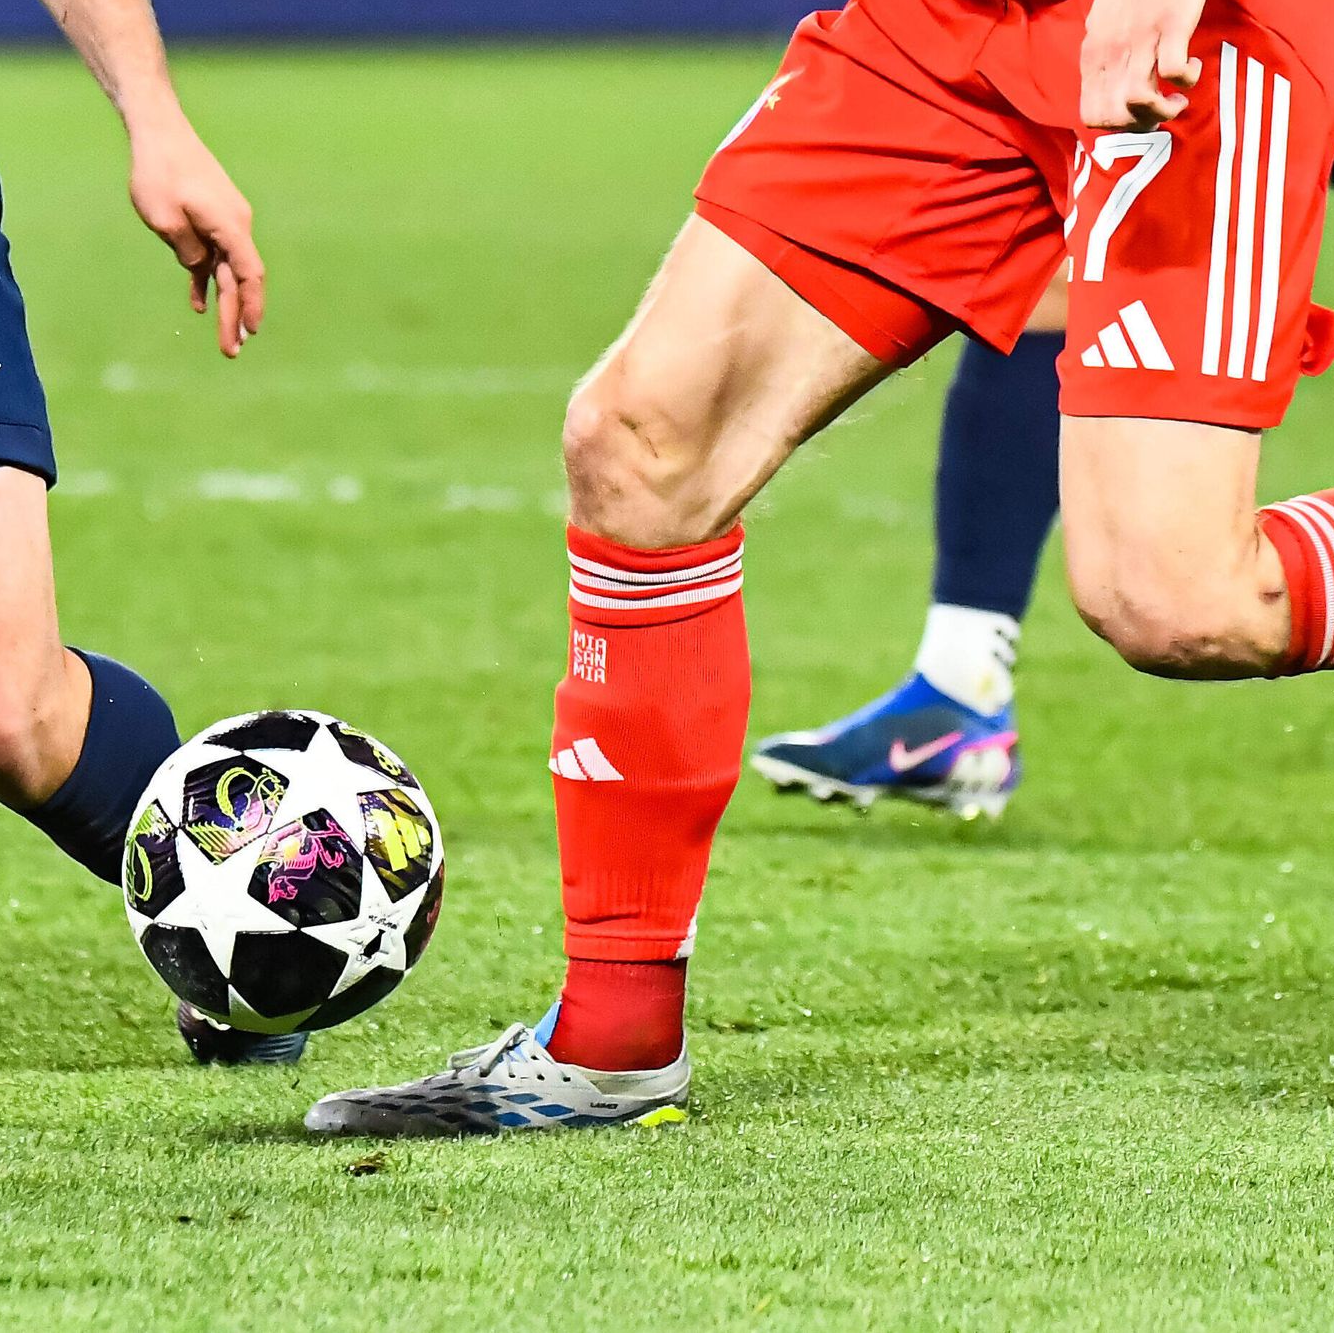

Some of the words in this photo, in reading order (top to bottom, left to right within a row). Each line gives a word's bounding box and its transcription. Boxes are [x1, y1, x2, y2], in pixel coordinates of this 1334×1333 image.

[573, 629, 607, 653] MIA
[574, 646, 606, 669] SAN
[573, 661, 606, 684] MIA
